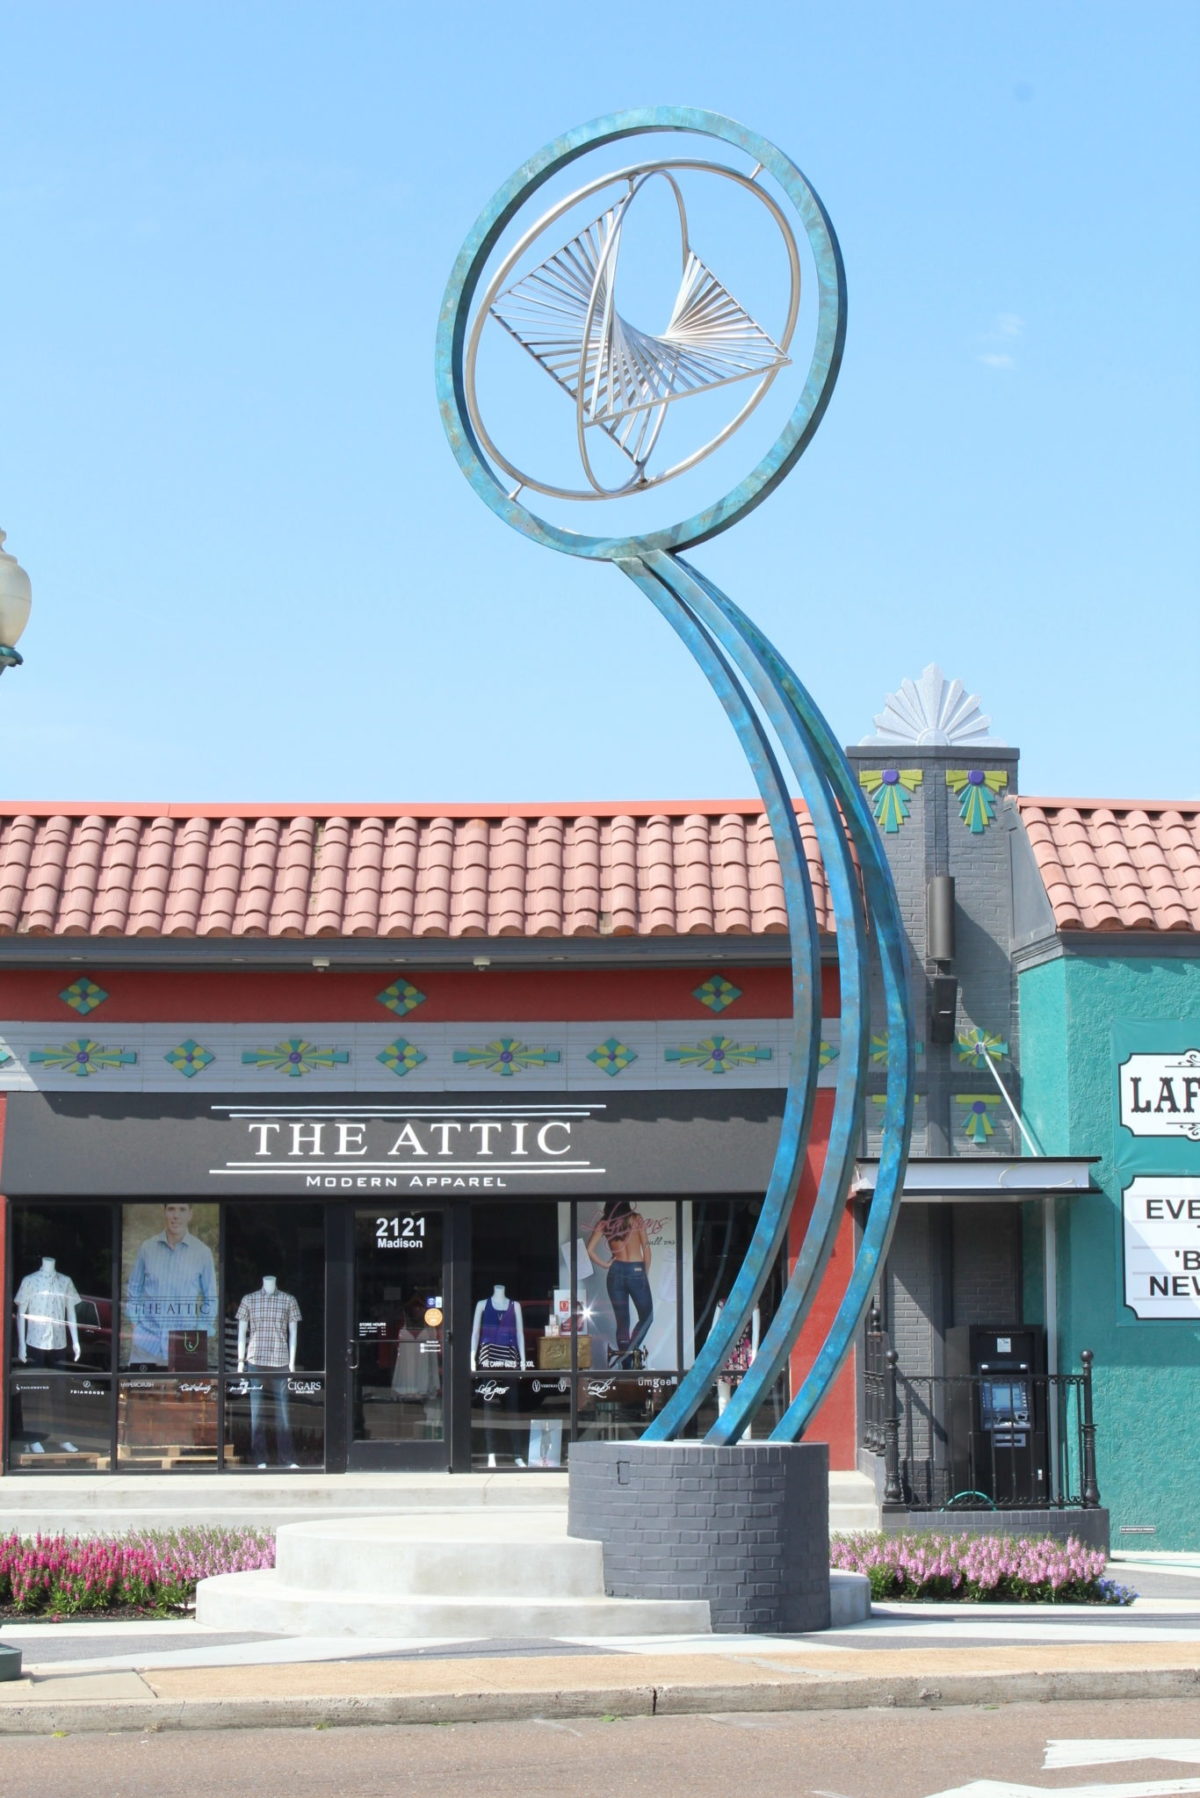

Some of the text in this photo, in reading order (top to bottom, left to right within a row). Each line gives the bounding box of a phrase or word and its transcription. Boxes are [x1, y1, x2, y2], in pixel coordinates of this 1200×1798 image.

[1130, 1077, 1200, 1113] LAF
[248, 1121, 572, 1156] THE ATTIC
[306, 1175, 507, 1188] MODERN APPAREL
[375, 1217, 426, 1237] 2121
[377, 1238, 423, 1249] Madison
[132, 1303, 211, 1316] THE ATTIC
[287, 1381, 322, 1391] CIGARS
